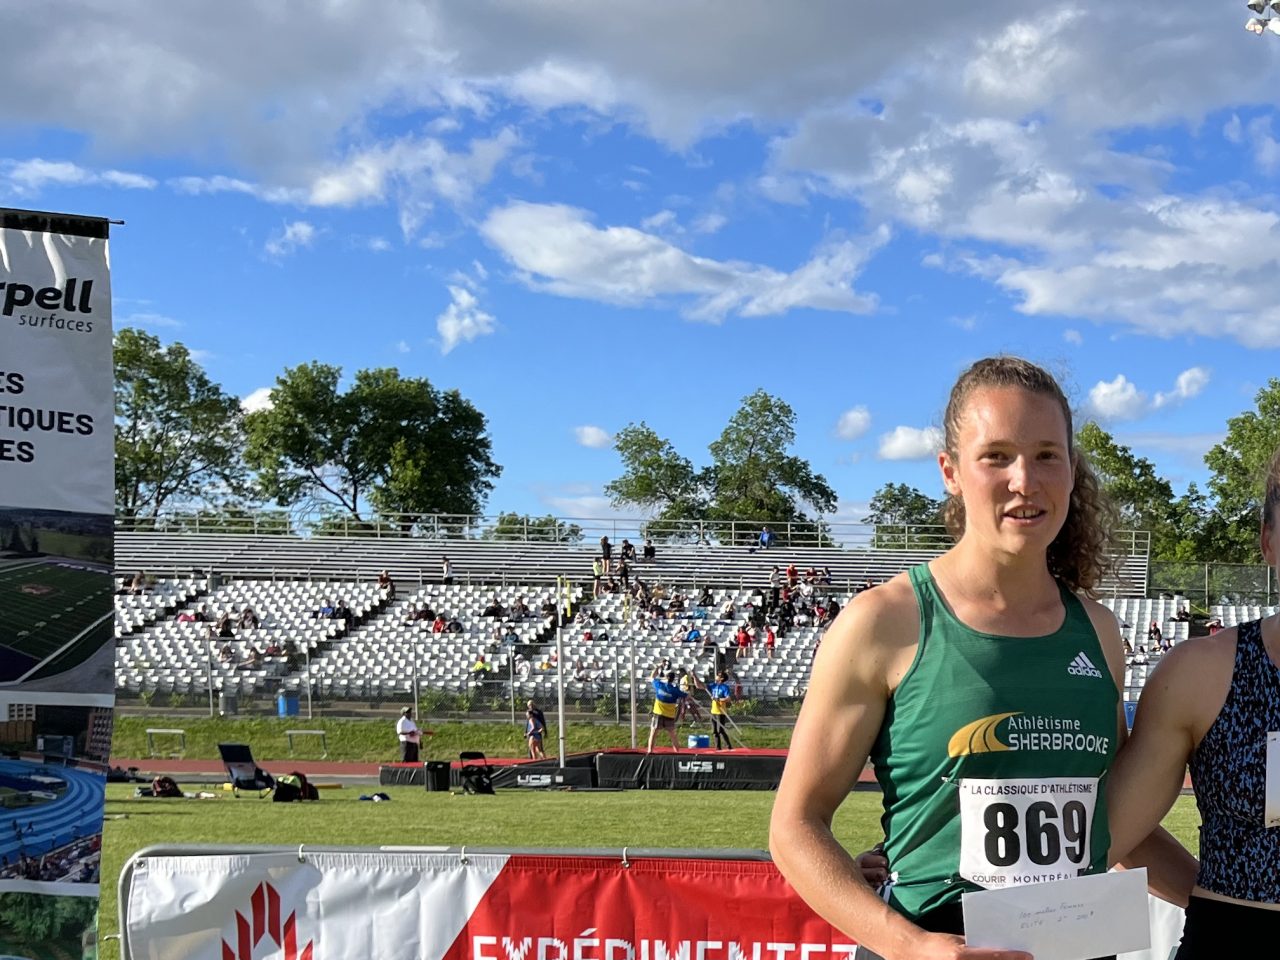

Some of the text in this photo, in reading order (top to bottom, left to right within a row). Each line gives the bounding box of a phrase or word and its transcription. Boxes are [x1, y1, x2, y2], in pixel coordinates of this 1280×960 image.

[0, 278, 93, 316] pell
[18, 313, 93, 333] surfaces
[1067, 666, 1103, 679] adidas
[1008, 715, 1081, 731] Athlétisme
[1008, 733, 1109, 755] SHERBROOKE
[678, 761, 713, 770] UCS
[517, 774, 551, 784] UCS
[971, 782, 1093, 796] LA CLASSIQUE D'ATHLÉTISME
[983, 800, 1087, 867] 869
[972, 873, 1006, 884] COURIR
